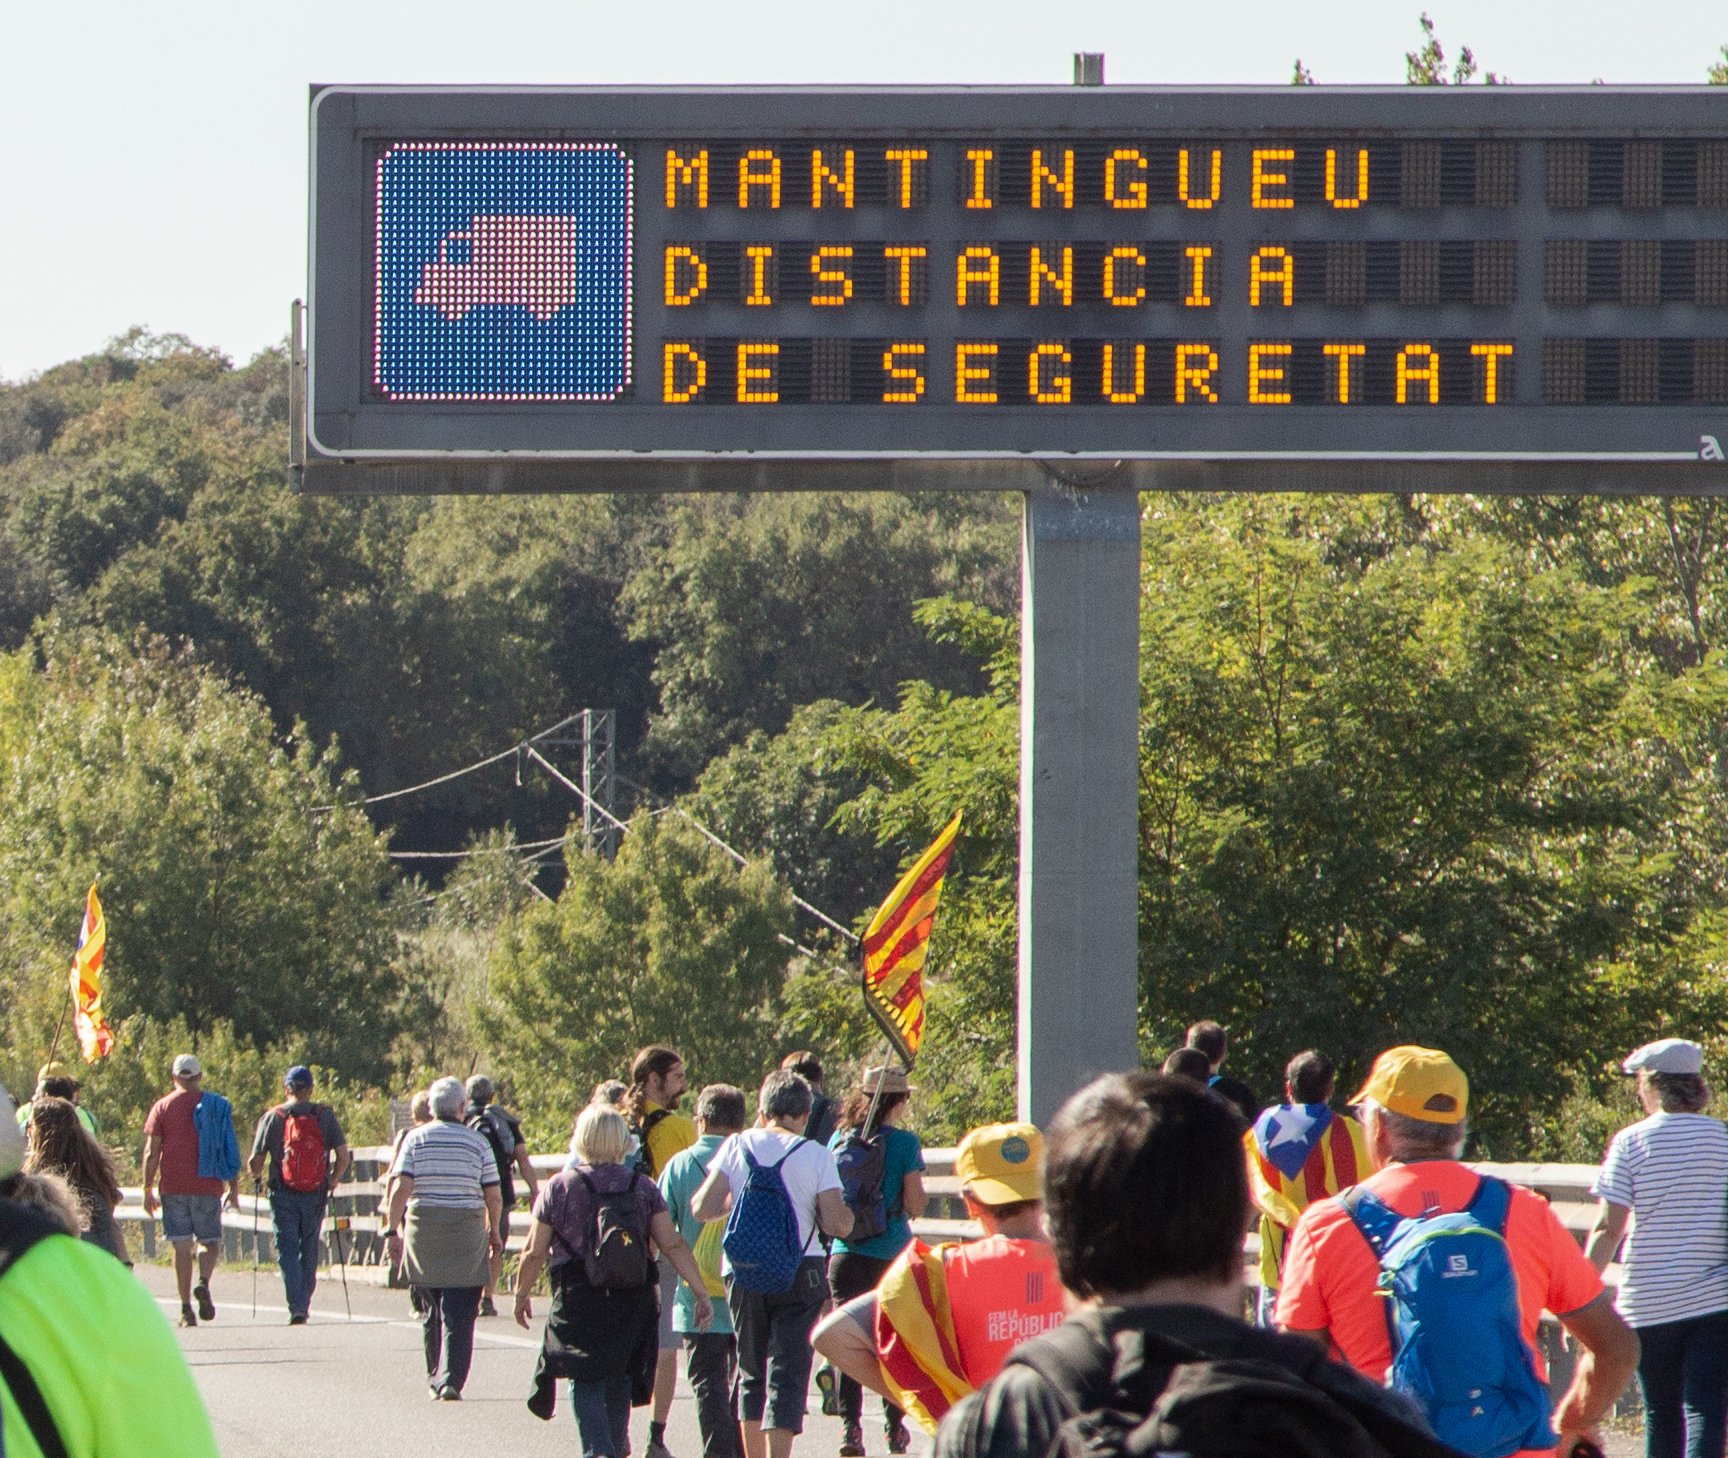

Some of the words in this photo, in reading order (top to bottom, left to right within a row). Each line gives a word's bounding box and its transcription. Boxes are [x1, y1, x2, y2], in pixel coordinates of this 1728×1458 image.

[665, 149, 1369, 209] MANTINGUEU
[664, 246, 1294, 307] DISTANCIA
[663, 343, 780, 404] DE
[882, 343, 1513, 404] SEGURETAT
